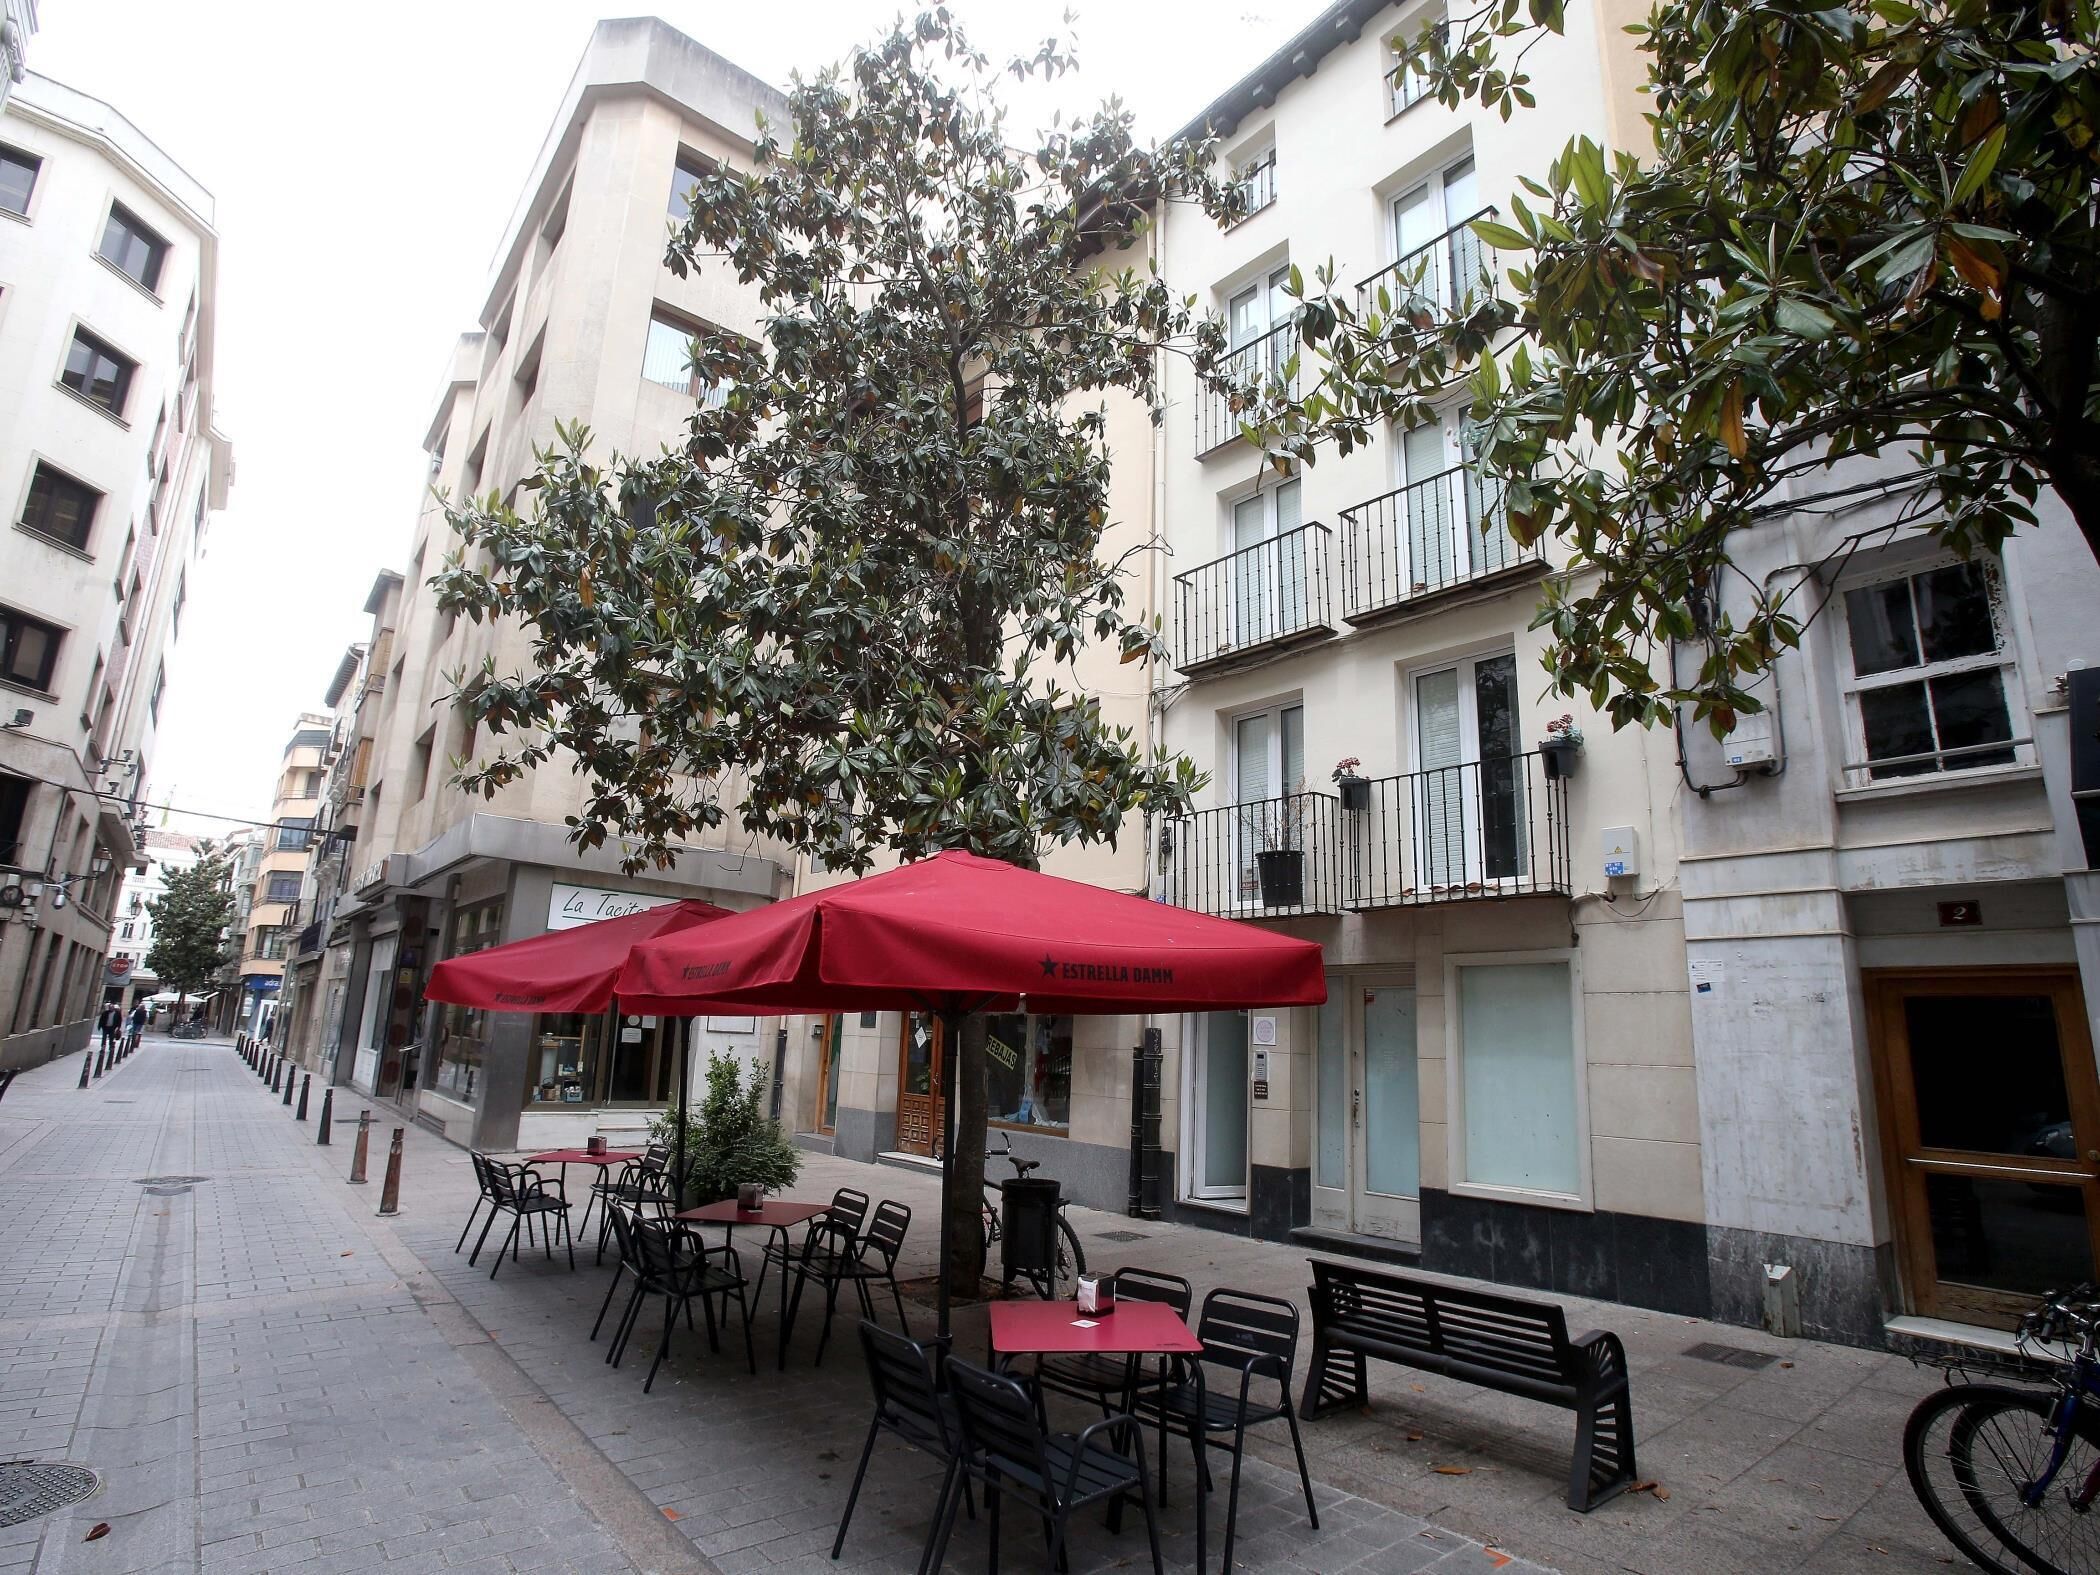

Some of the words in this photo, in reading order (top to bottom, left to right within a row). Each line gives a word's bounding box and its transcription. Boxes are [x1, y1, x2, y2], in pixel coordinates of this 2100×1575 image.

[563, 891, 583, 913] La
[1952, 906, 1967, 920] 2
[1062, 962, 1129, 982] ESTRELLA
[1133, 966, 1174, 984] DAMM
[985, 1035, 1018, 1068] REBAJAS
